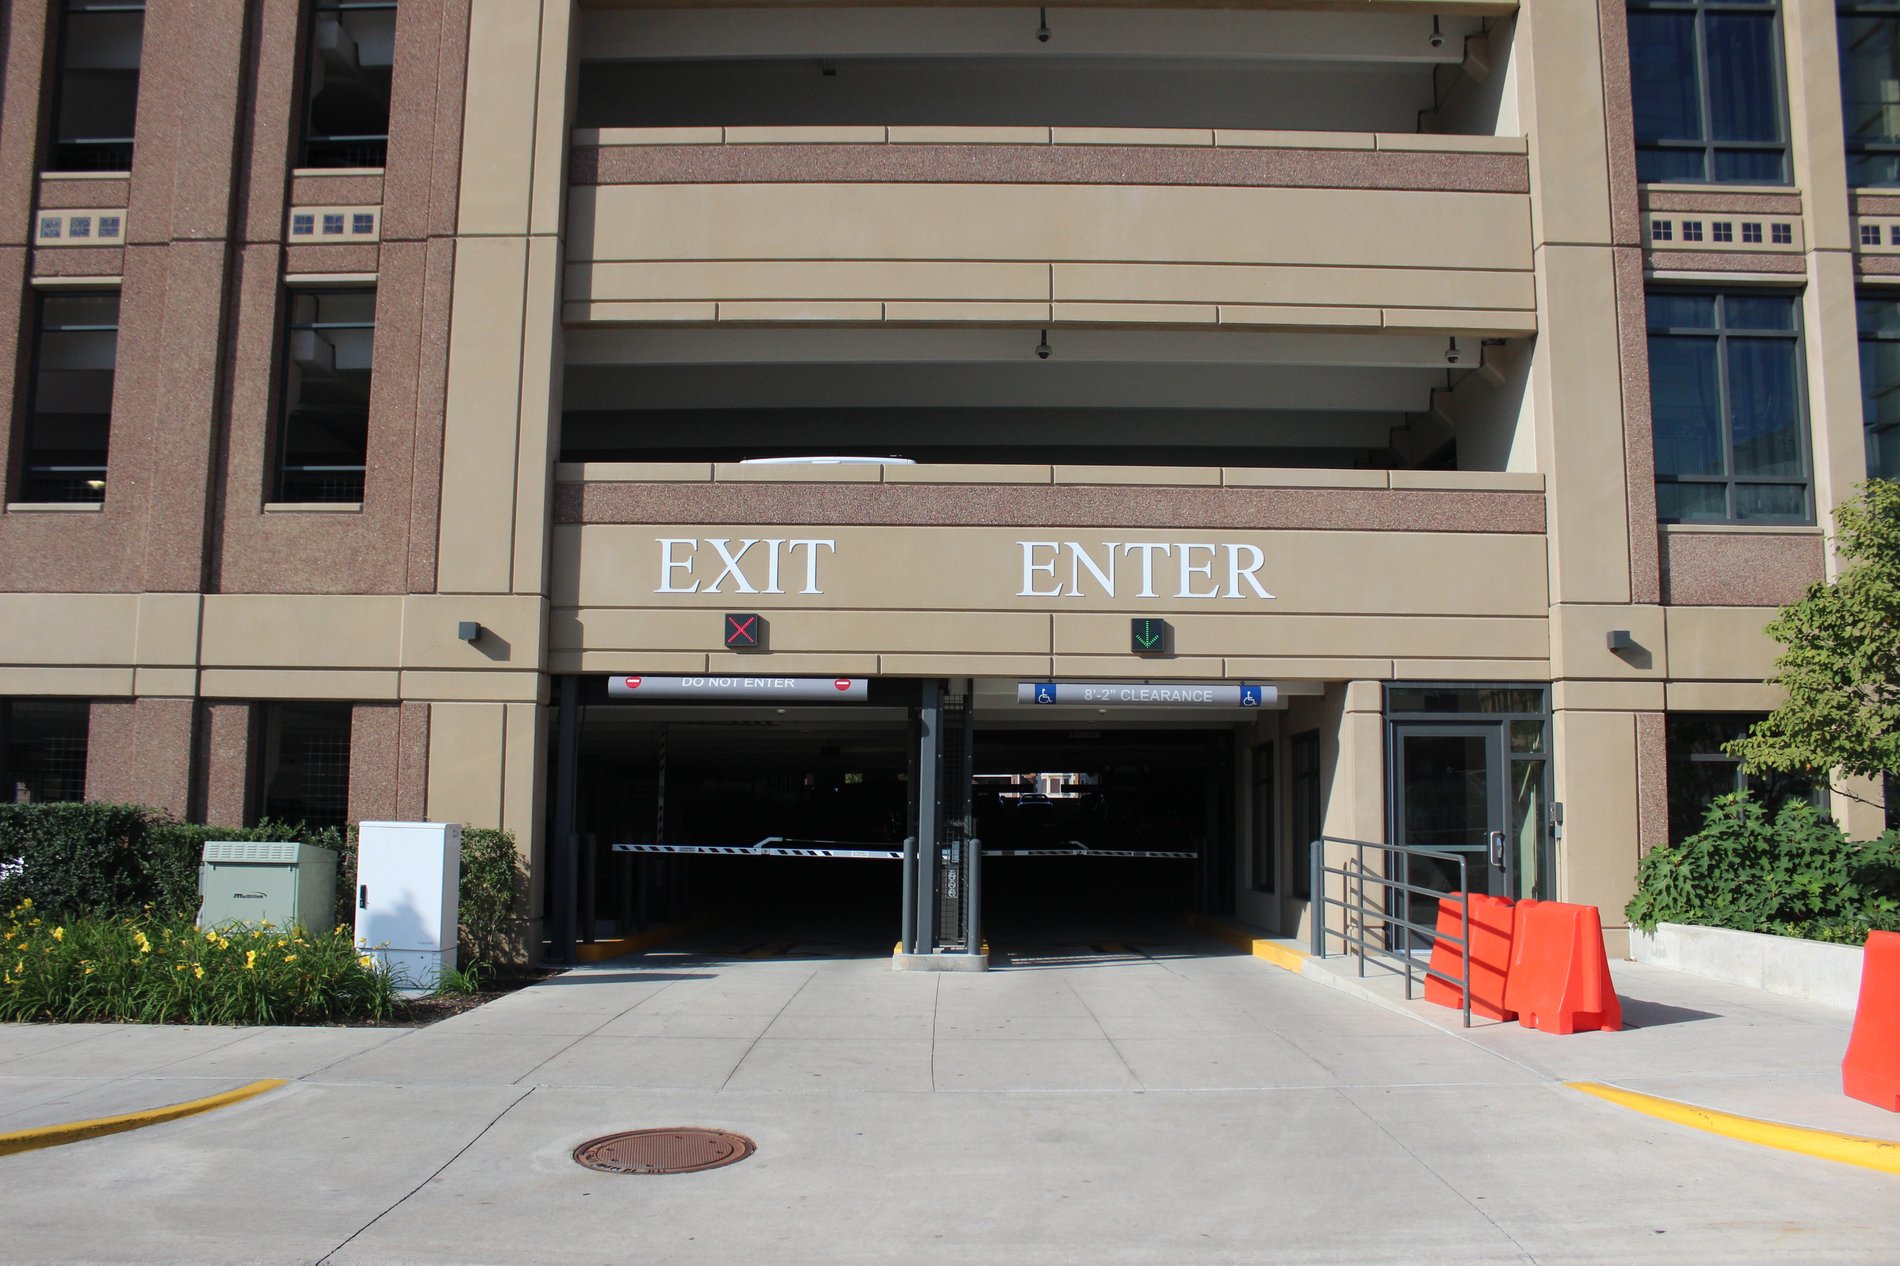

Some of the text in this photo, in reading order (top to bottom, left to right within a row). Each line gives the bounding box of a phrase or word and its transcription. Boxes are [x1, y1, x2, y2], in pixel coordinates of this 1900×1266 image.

[654, 538, 836, 594] EXIT
[1015, 541, 1277, 599] ENTER
[682, 677, 795, 688] DO NOT ENTER
[1120, 689, 1213, 702] CLEARANCE
